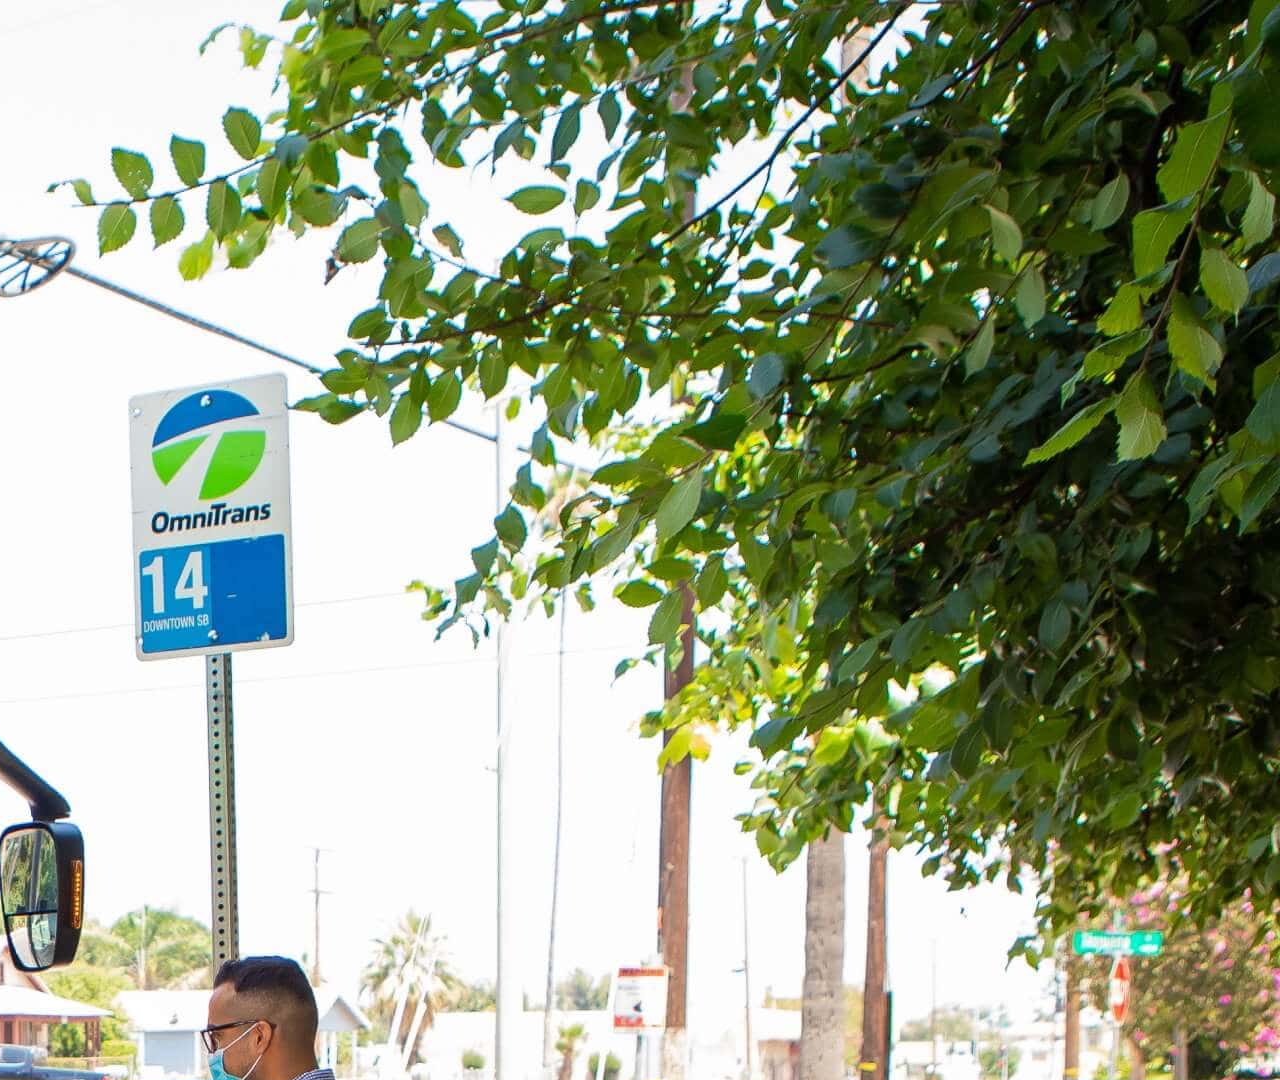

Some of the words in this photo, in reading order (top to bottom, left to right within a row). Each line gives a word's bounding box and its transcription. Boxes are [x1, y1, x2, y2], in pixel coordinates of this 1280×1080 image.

[151, 502, 271, 534] OmniTrans
[142, 550, 208, 614] 14
[144, 616, 195, 633] DOWNTOWN
[197, 614, 209, 627] SB
